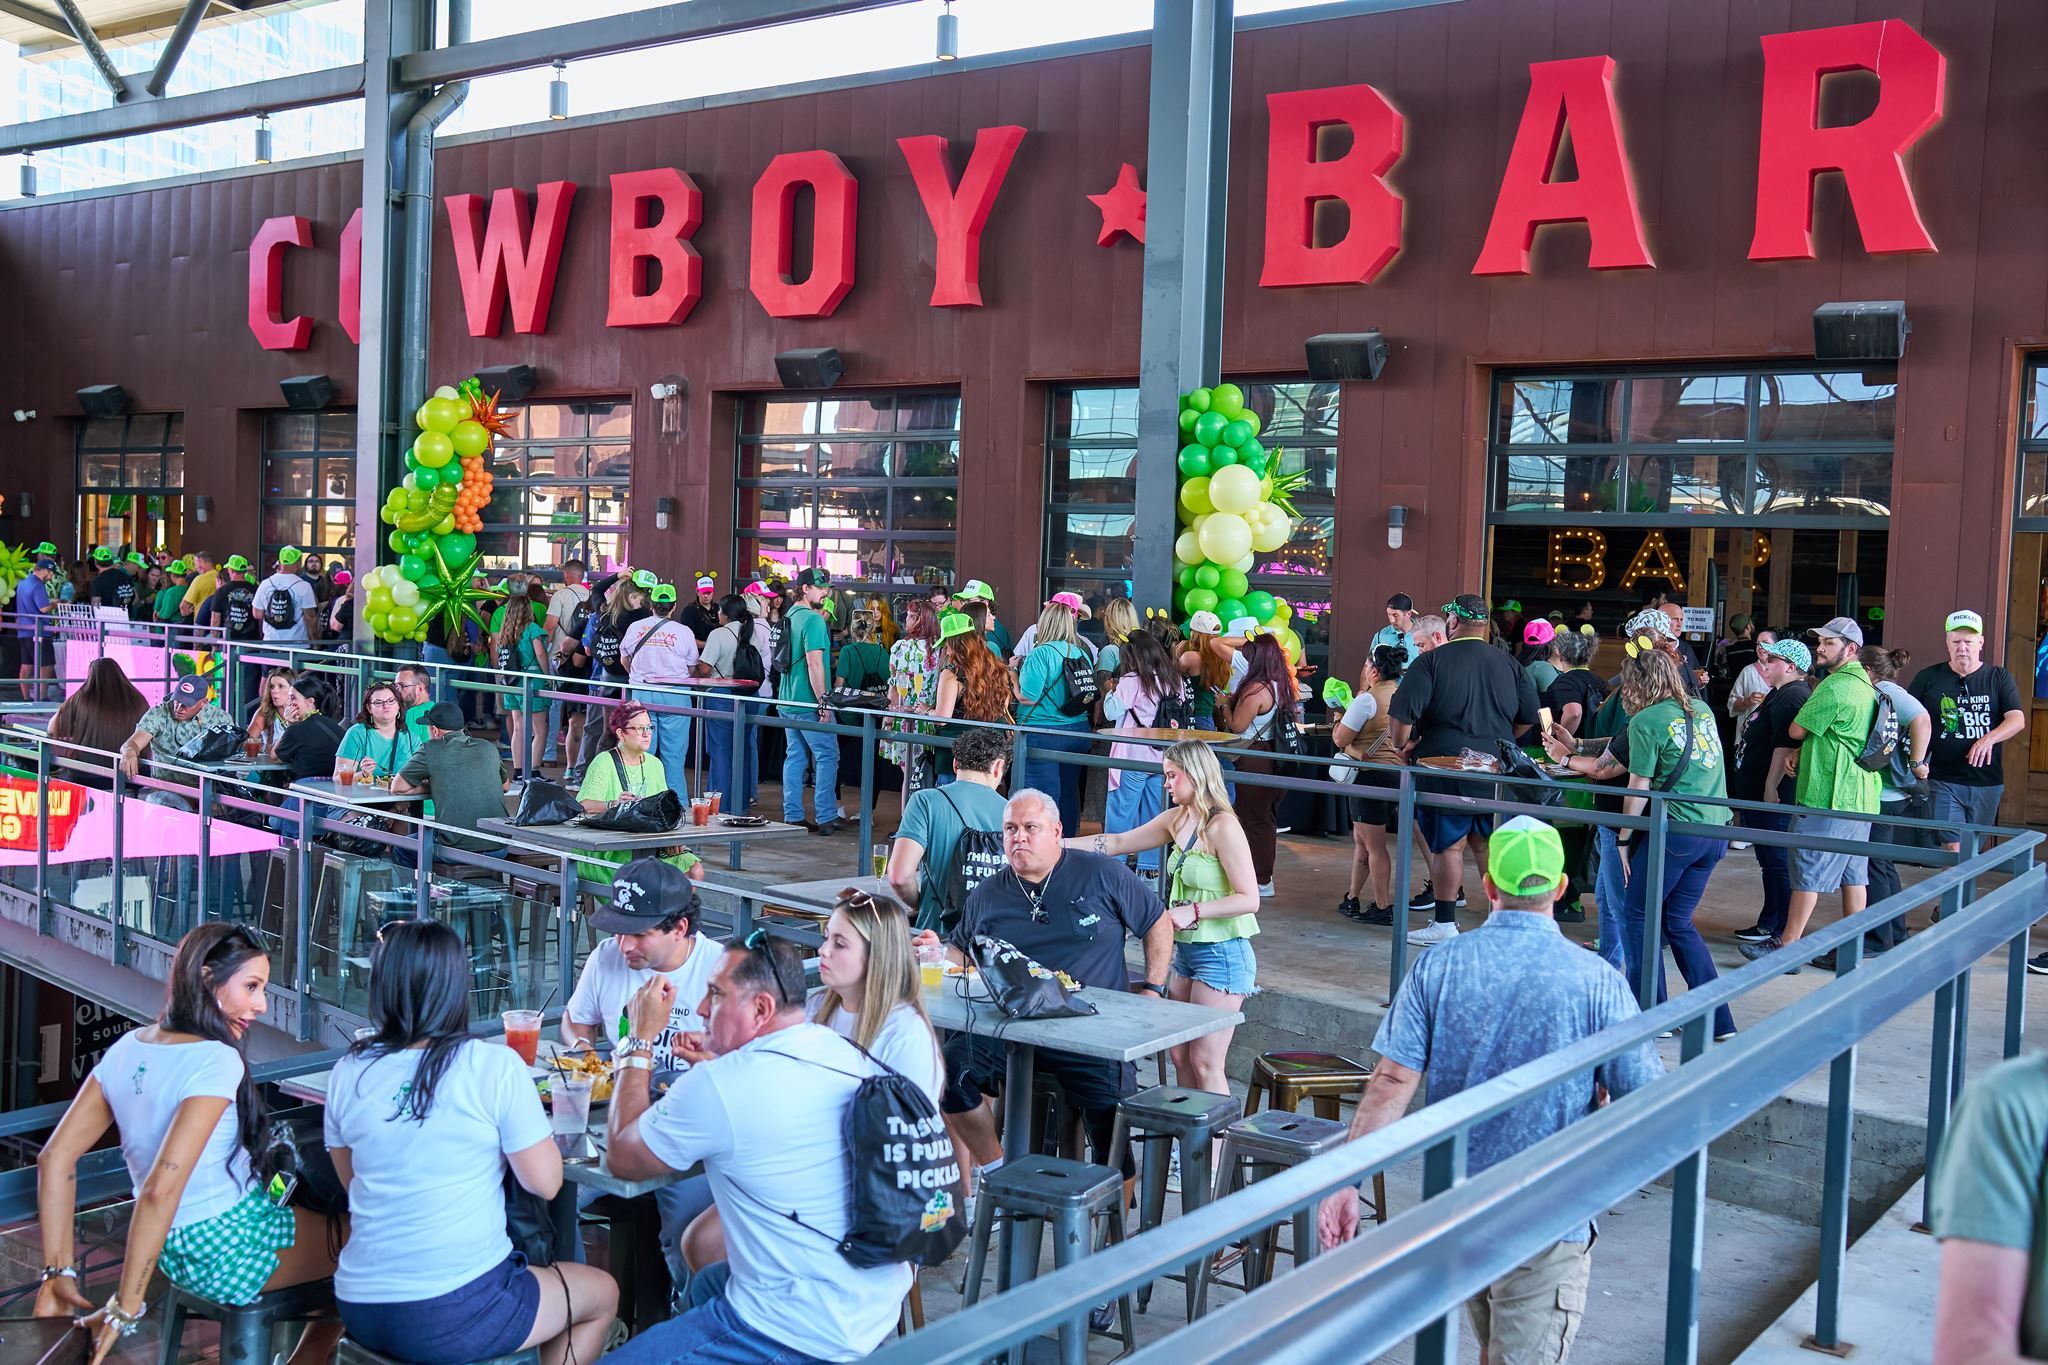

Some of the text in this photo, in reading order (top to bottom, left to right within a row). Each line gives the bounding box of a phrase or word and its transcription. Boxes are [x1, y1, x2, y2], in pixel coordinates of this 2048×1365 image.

[249, 18, 1947, 351] CWBOY BAR
[1970, 695, 1990, 704] KIND
[1963, 712, 1991, 726] BIG
[967, 851, 1009, 865] THIS BA
[962, 865, 1002, 878] IS FU
[883, 1143, 907, 1163] IS
[896, 1162, 960, 1189] PICKLE
